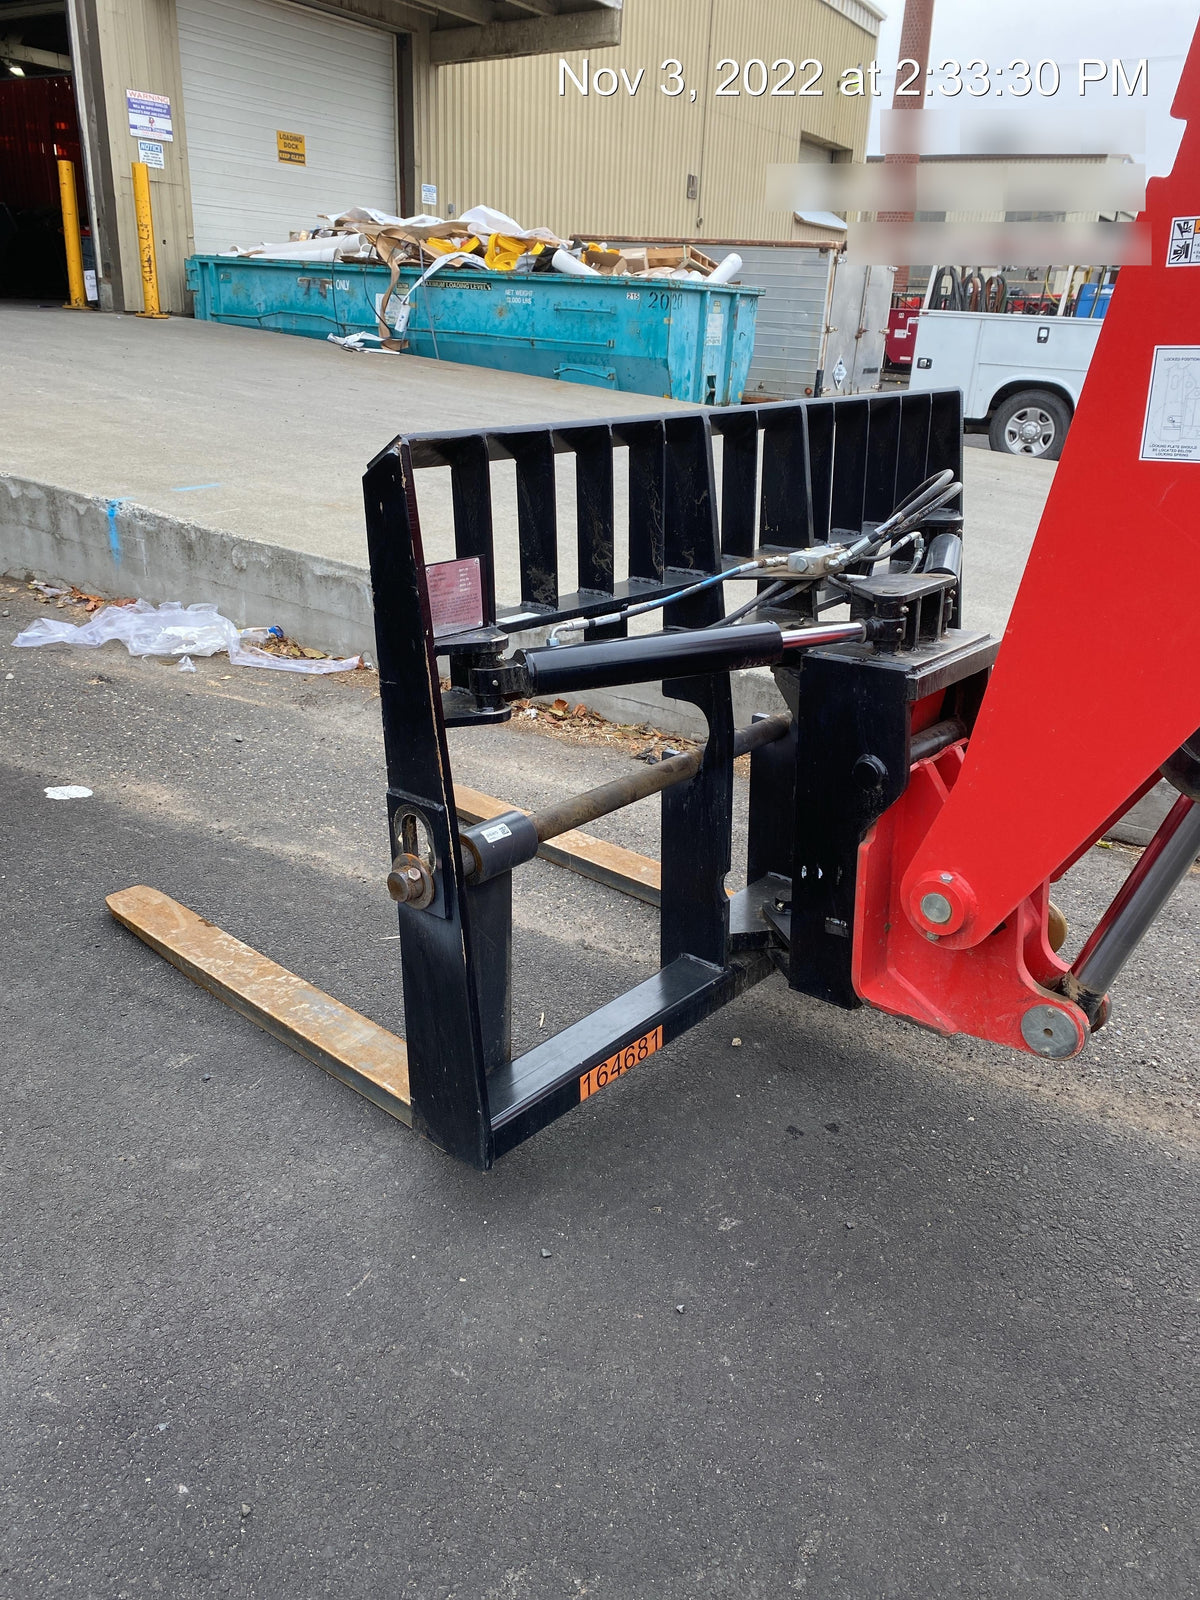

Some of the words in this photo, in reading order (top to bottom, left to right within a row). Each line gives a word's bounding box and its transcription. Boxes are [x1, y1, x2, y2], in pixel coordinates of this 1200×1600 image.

[128, 90, 169, 104] WARNING
[279, 132, 303, 143] LOADING
[140, 142, 162, 153] NOTICE
[283, 141, 299, 150] DOCK
[335, 279, 350, 291] ONLY
[445, 281, 469, 290] LOADING
[515, 289, 533, 297] WEIGHT
[648, 291, 670, 311] 20
[583, 1028, 659, 1097] 164681
